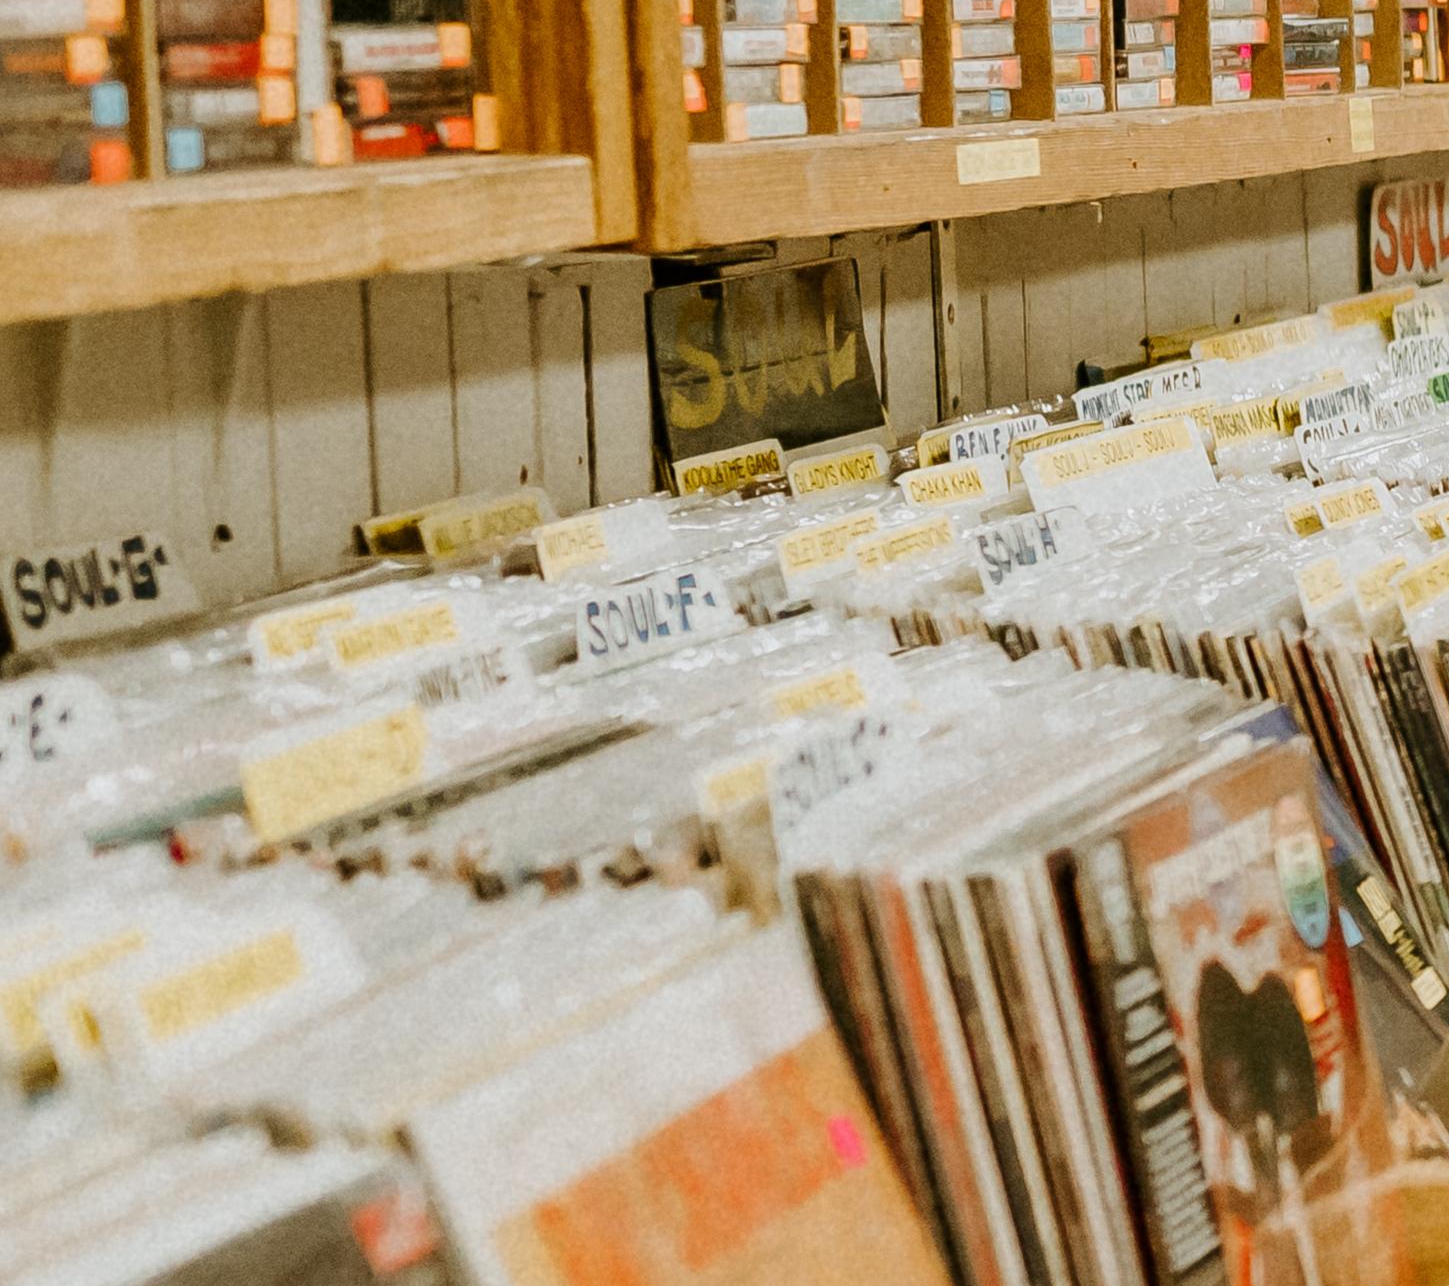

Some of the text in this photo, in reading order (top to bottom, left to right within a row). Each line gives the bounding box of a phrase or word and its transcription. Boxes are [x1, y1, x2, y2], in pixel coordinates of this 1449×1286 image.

[1081, 388, 1121, 420] MIDNIGHT
[747, 449, 780, 476] GANG
[793, 453, 881, 495] GLADYS KNIGHT
[909, 467, 984, 503] CHAKA KHAN
[15, 551, 119, 630] SOUL
[586, 586, 671, 657] SOUL
